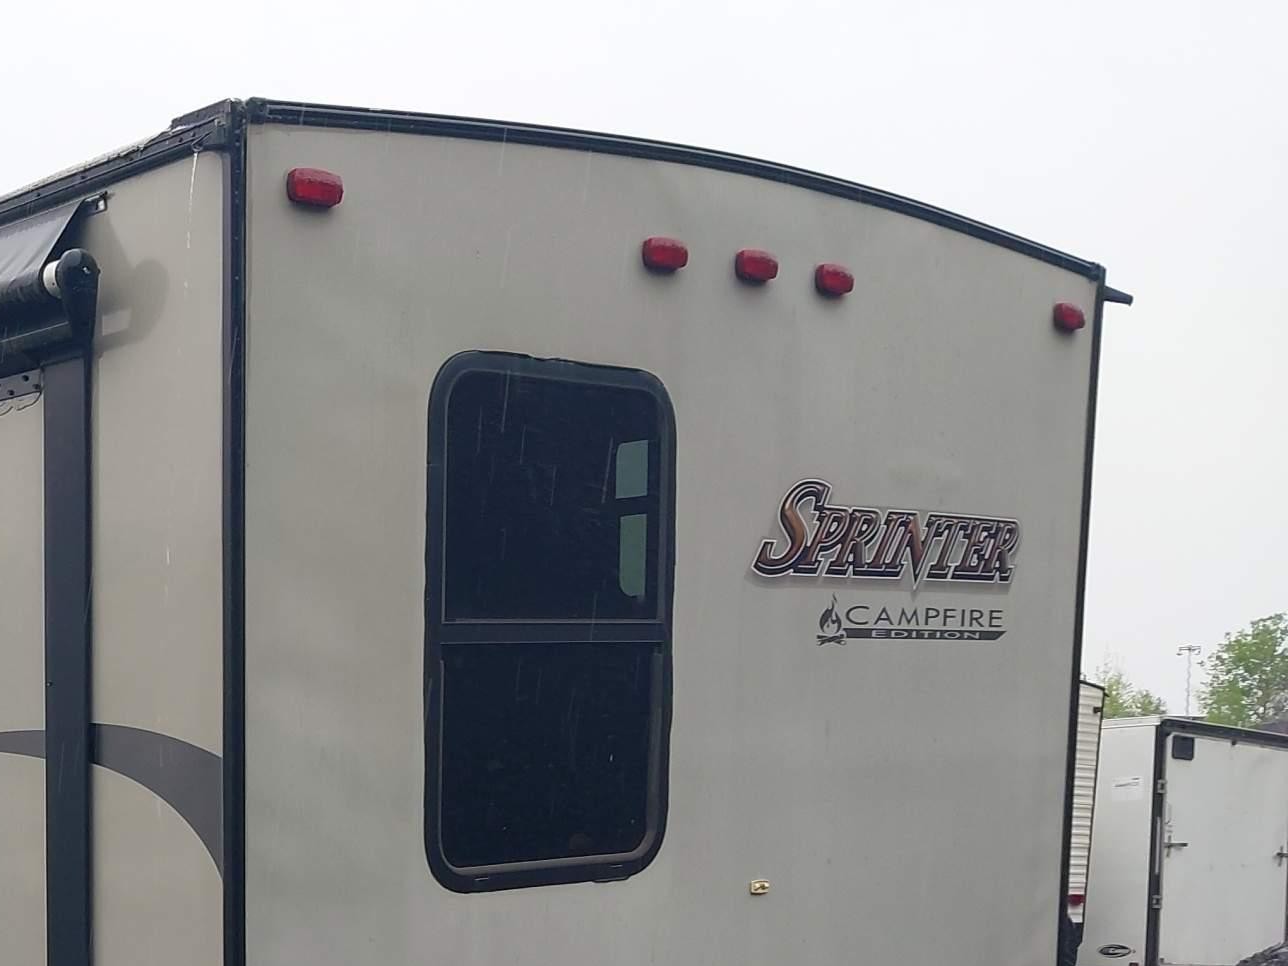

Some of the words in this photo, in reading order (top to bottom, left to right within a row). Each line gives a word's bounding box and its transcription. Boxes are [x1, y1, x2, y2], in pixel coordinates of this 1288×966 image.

[753, 479, 1020, 589] SPRINTER
[845, 605, 1003, 628] CAMPFIRE
[870, 629, 980, 640] EDITION
